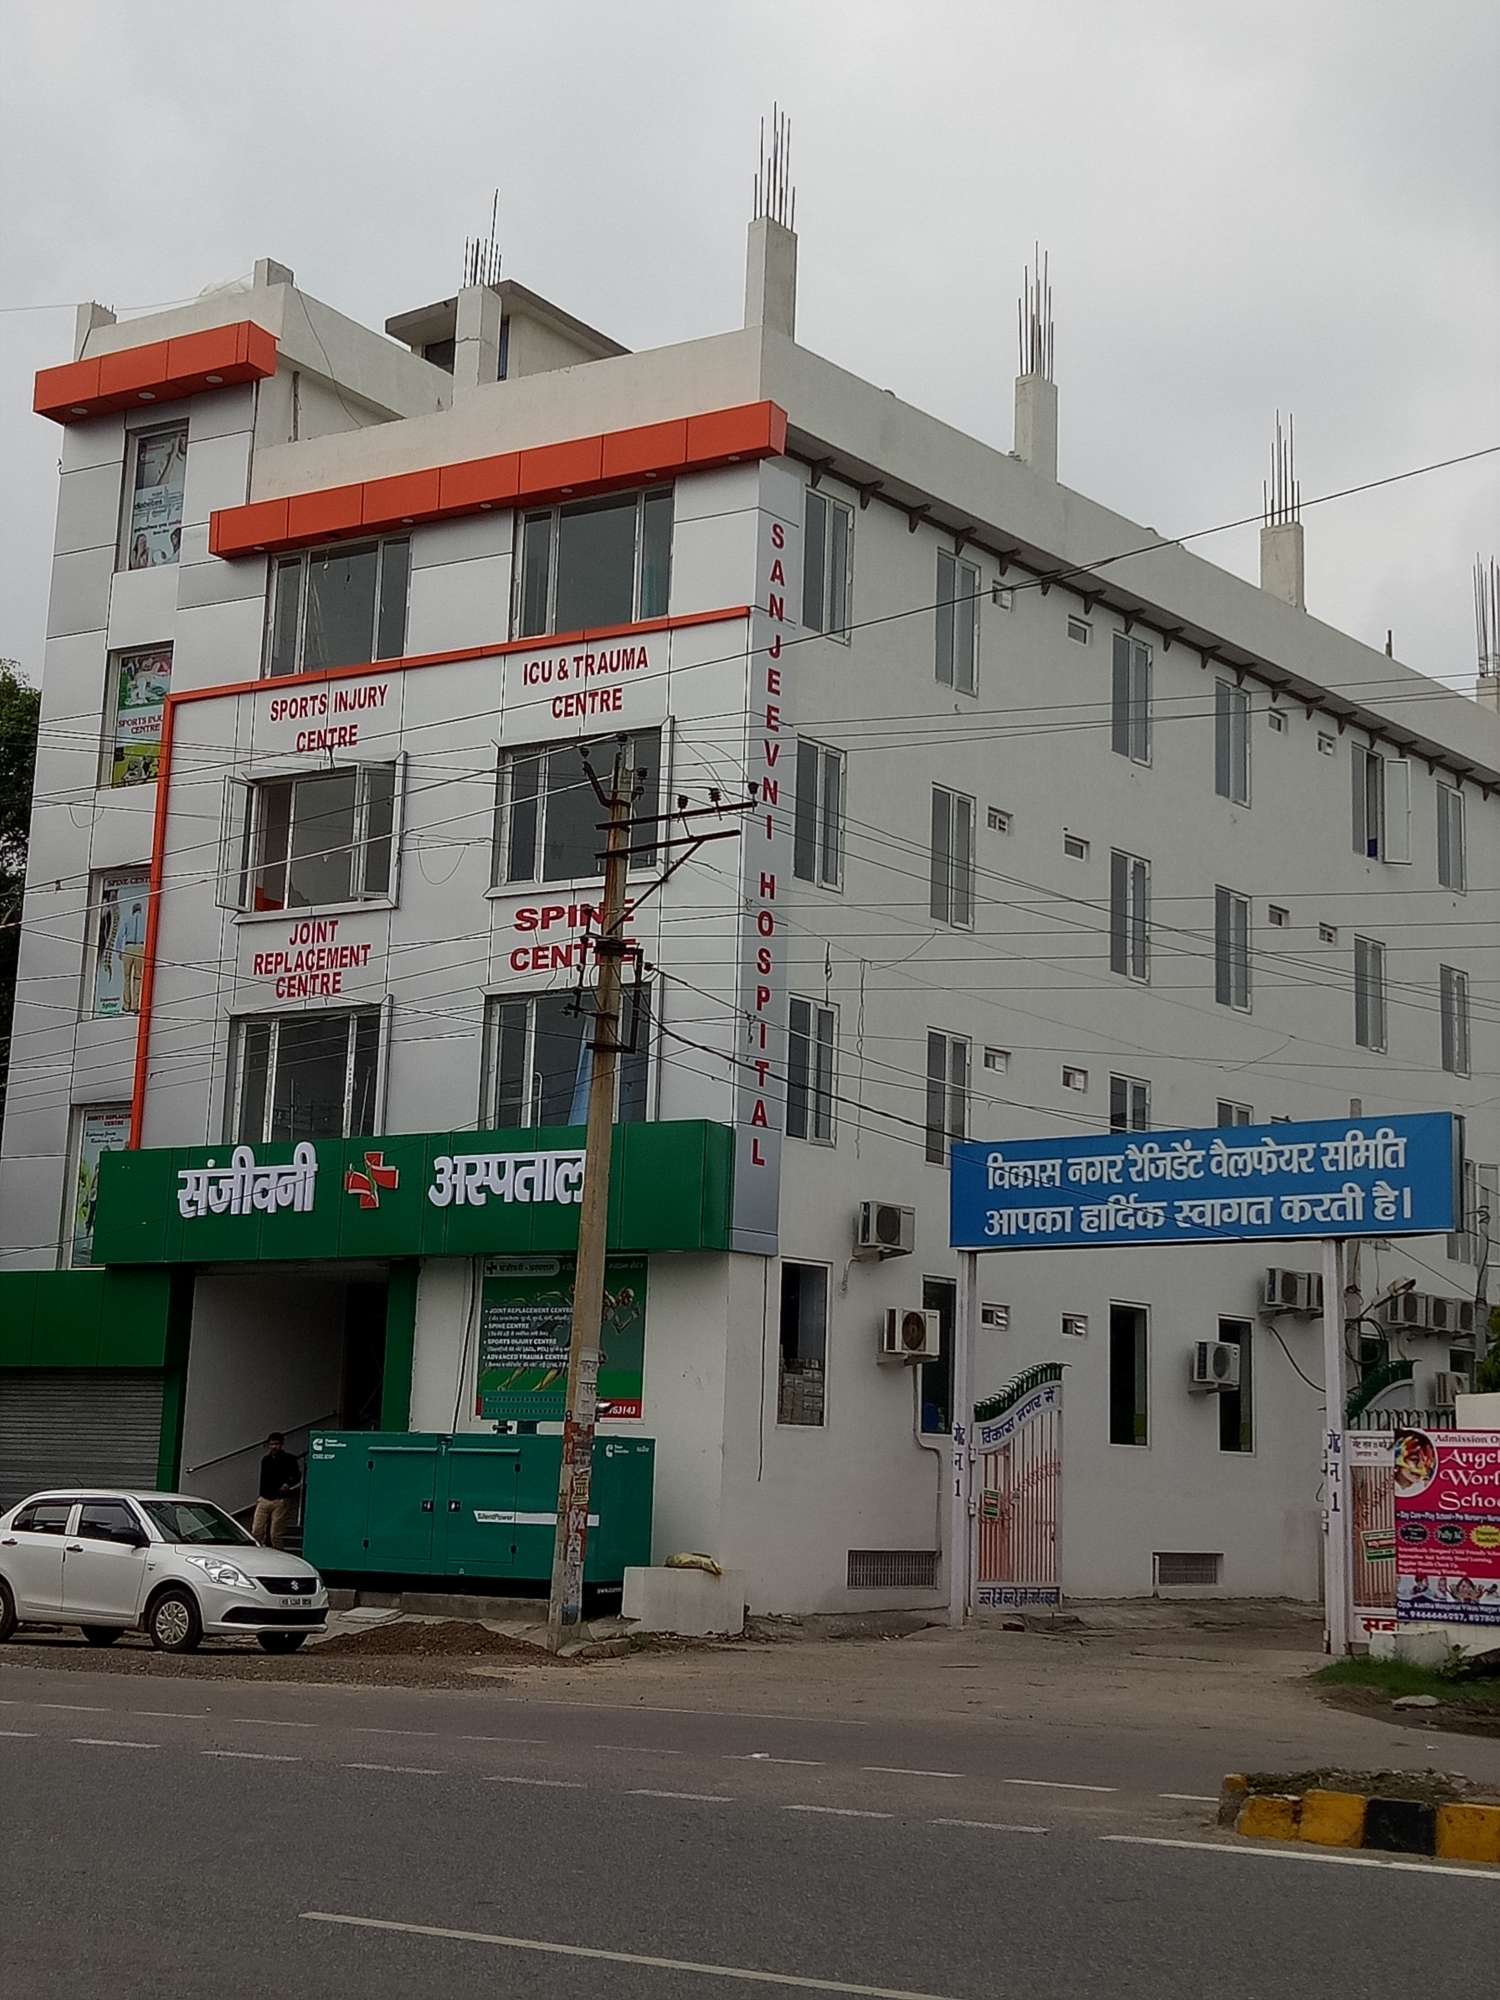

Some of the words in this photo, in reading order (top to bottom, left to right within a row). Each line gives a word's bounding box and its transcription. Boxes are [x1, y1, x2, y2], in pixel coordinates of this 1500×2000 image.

[522, 656, 552, 686] ICU
[557, 657, 570, 680] &
[572, 646, 648, 678] TRAUMA
[762, 523, 786, 840] SANJEEVNI
[270, 692, 328, 722] SPORTS
[333, 684, 388, 713] INJURY
[552, 688, 623, 720] CENTRE
[118, 717, 146, 728] SPORTS
[131, 724, 160, 734] CENTRE
[296, 724, 358, 752] CENTRE
[289, 920, 339, 946] JOINT
[254, 943, 372, 975] REPLACEMENT
[510, 937, 636, 972] CENT
[275, 971, 342, 998] CENTRE
[751, 872, 776, 1167] HOSPITAL
[987, 1151, 1062, 1190] विकास
[1067, 1155, 1124, 1185] नगर
[1210, 1137, 1316, 1178] वैलफेयर
[1320, 1127, 1407, 1172] समिति
[177, 1141, 319, 1218] संजीवनी
[427, 1150, 587, 1208] अस्पताल
[984, 1204, 1074, 1236] आपका
[1079, 1193, 1167, 1234] हार्दिक
[1173, 1195, 1274, 1228] स्वागत
[1280, 1182, 1364, 1224] करती
[982, 1416, 1015, 1444] विकास
[1016, 1396, 1042, 1422] नगर
[1436, 1434, 1488, 1444] Admission
[1440, 1449, 1500, 1470] Angel
